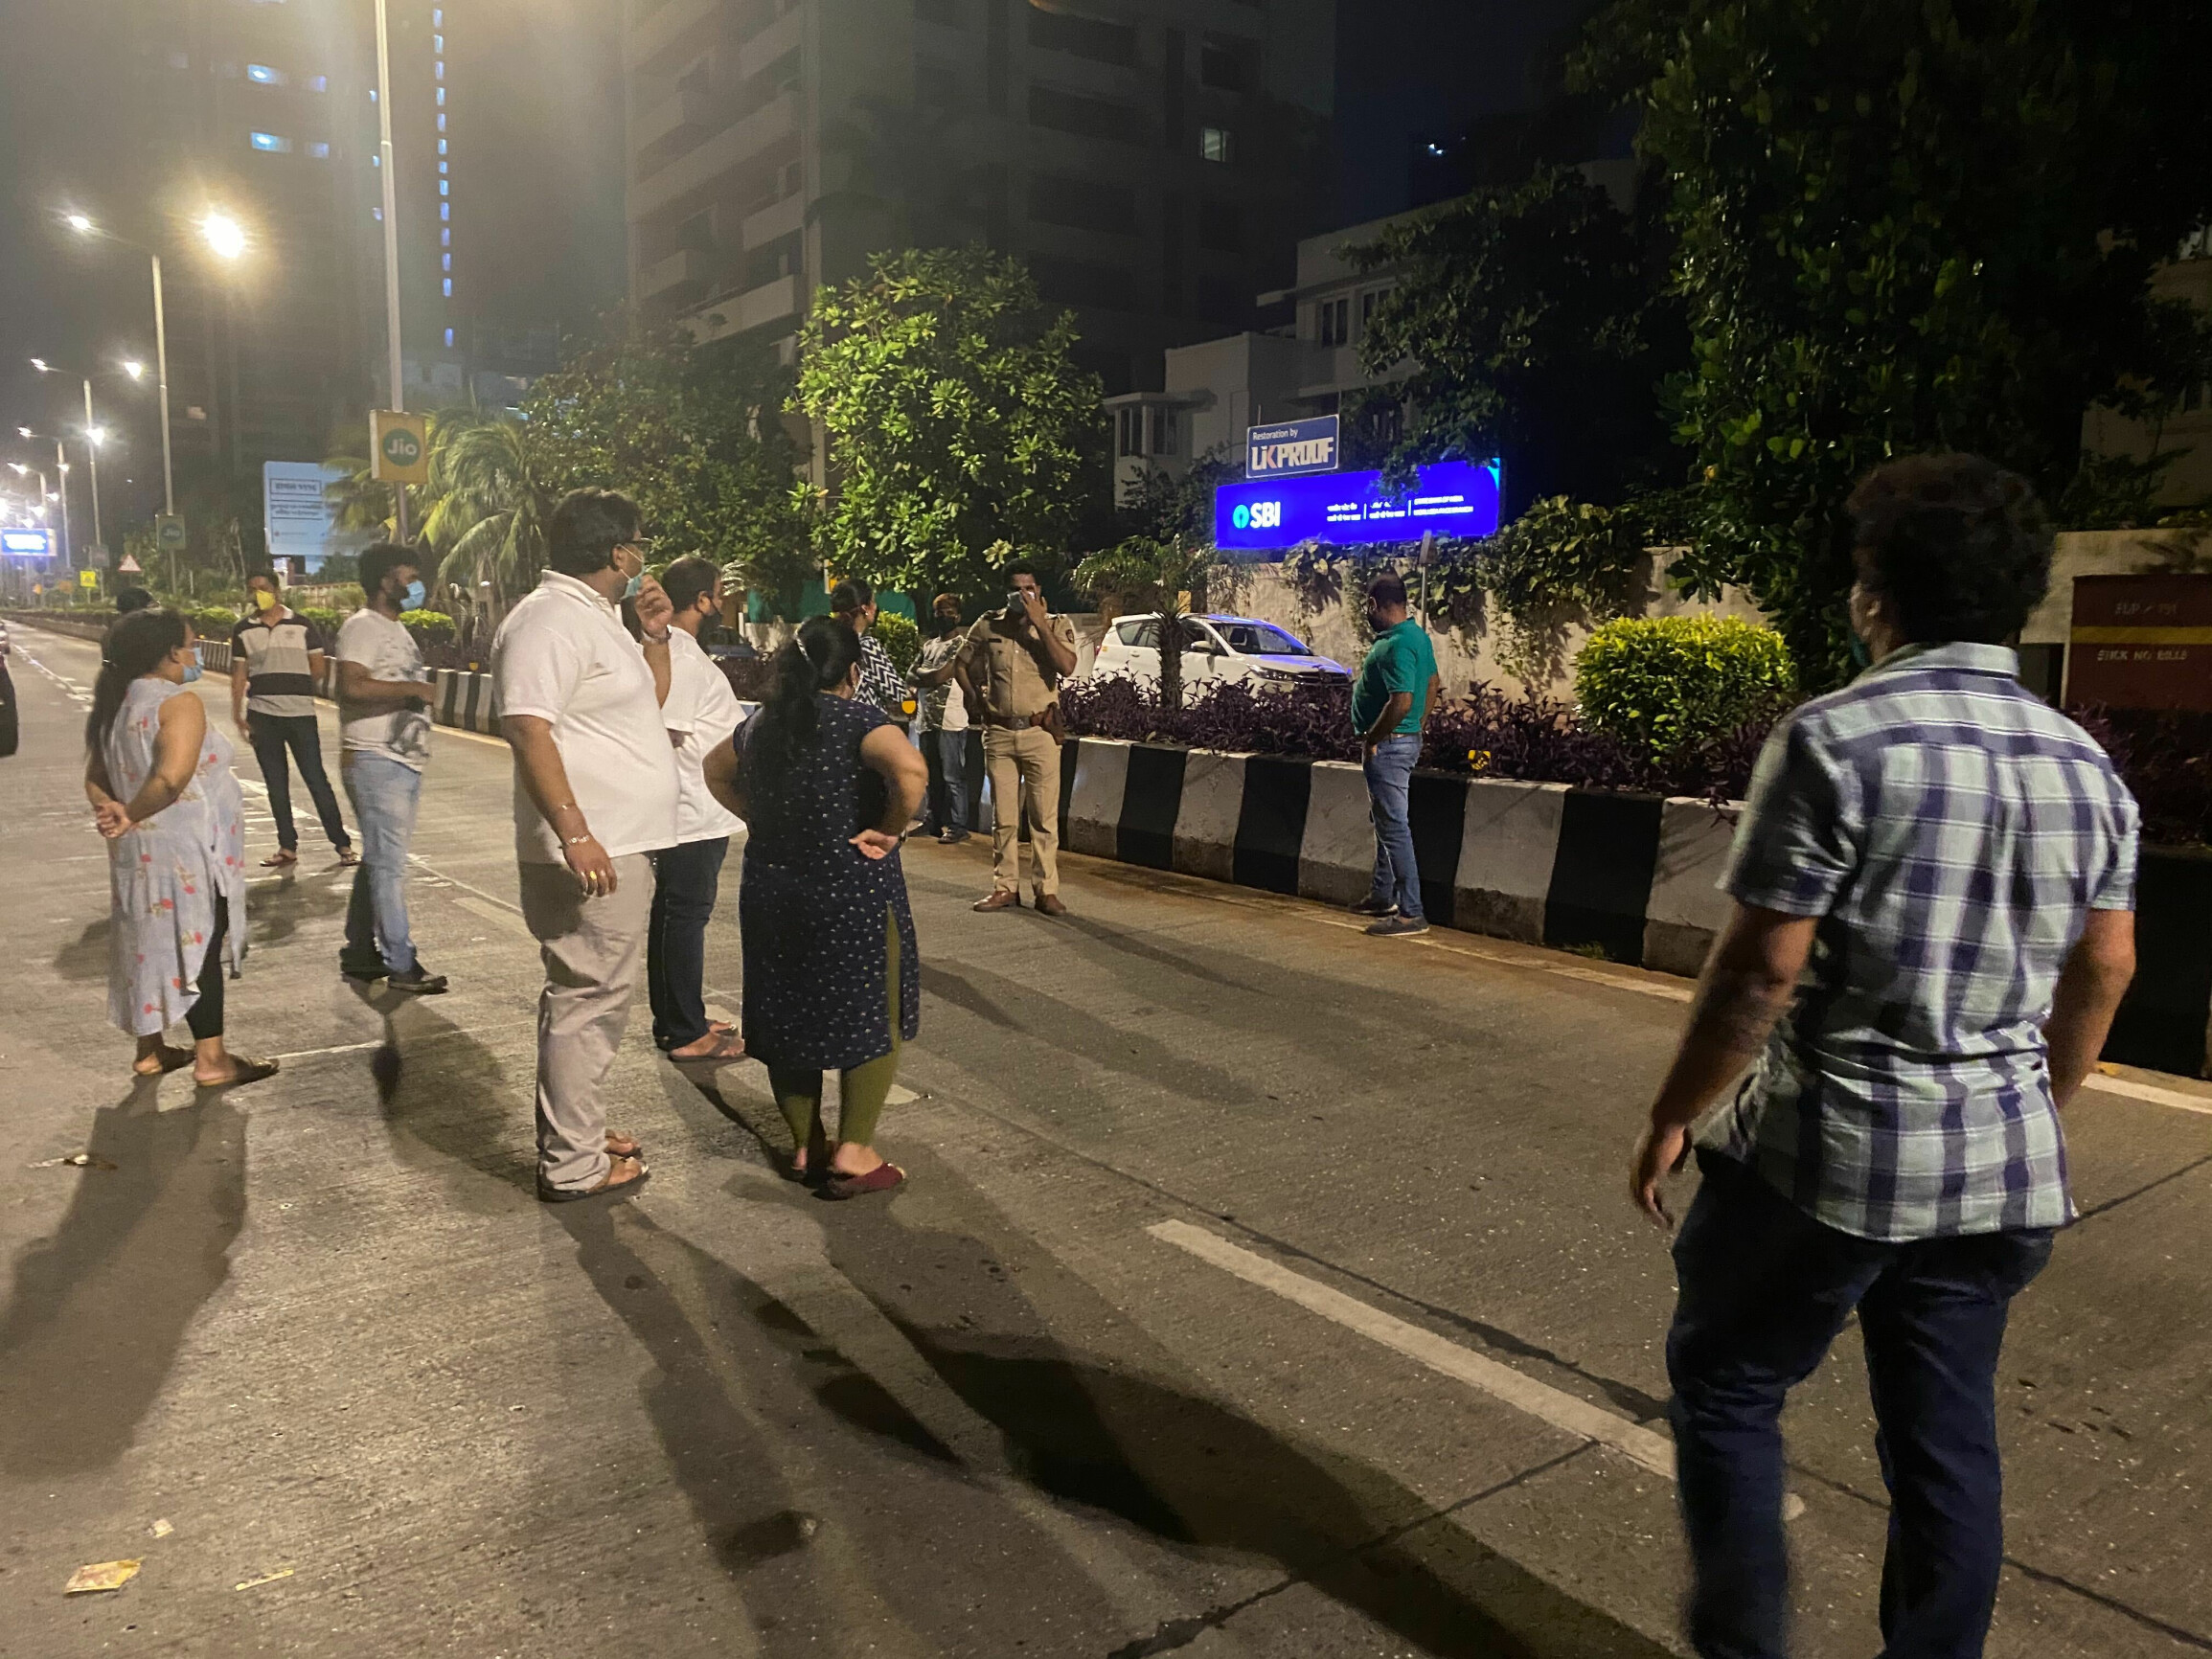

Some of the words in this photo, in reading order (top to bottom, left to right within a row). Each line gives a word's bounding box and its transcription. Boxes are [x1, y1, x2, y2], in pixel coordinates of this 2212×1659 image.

[1252, 429, 1288, 441] Restoration
[1289, 428, 1298, 438] by
[387, 438, 418, 456] Jio
[1249, 501, 1281, 529] SBI
[2097, 649, 2128, 662] STICK
[2133, 650, 2152, 661] NO
[2156, 649, 2188, 661] BILLS
